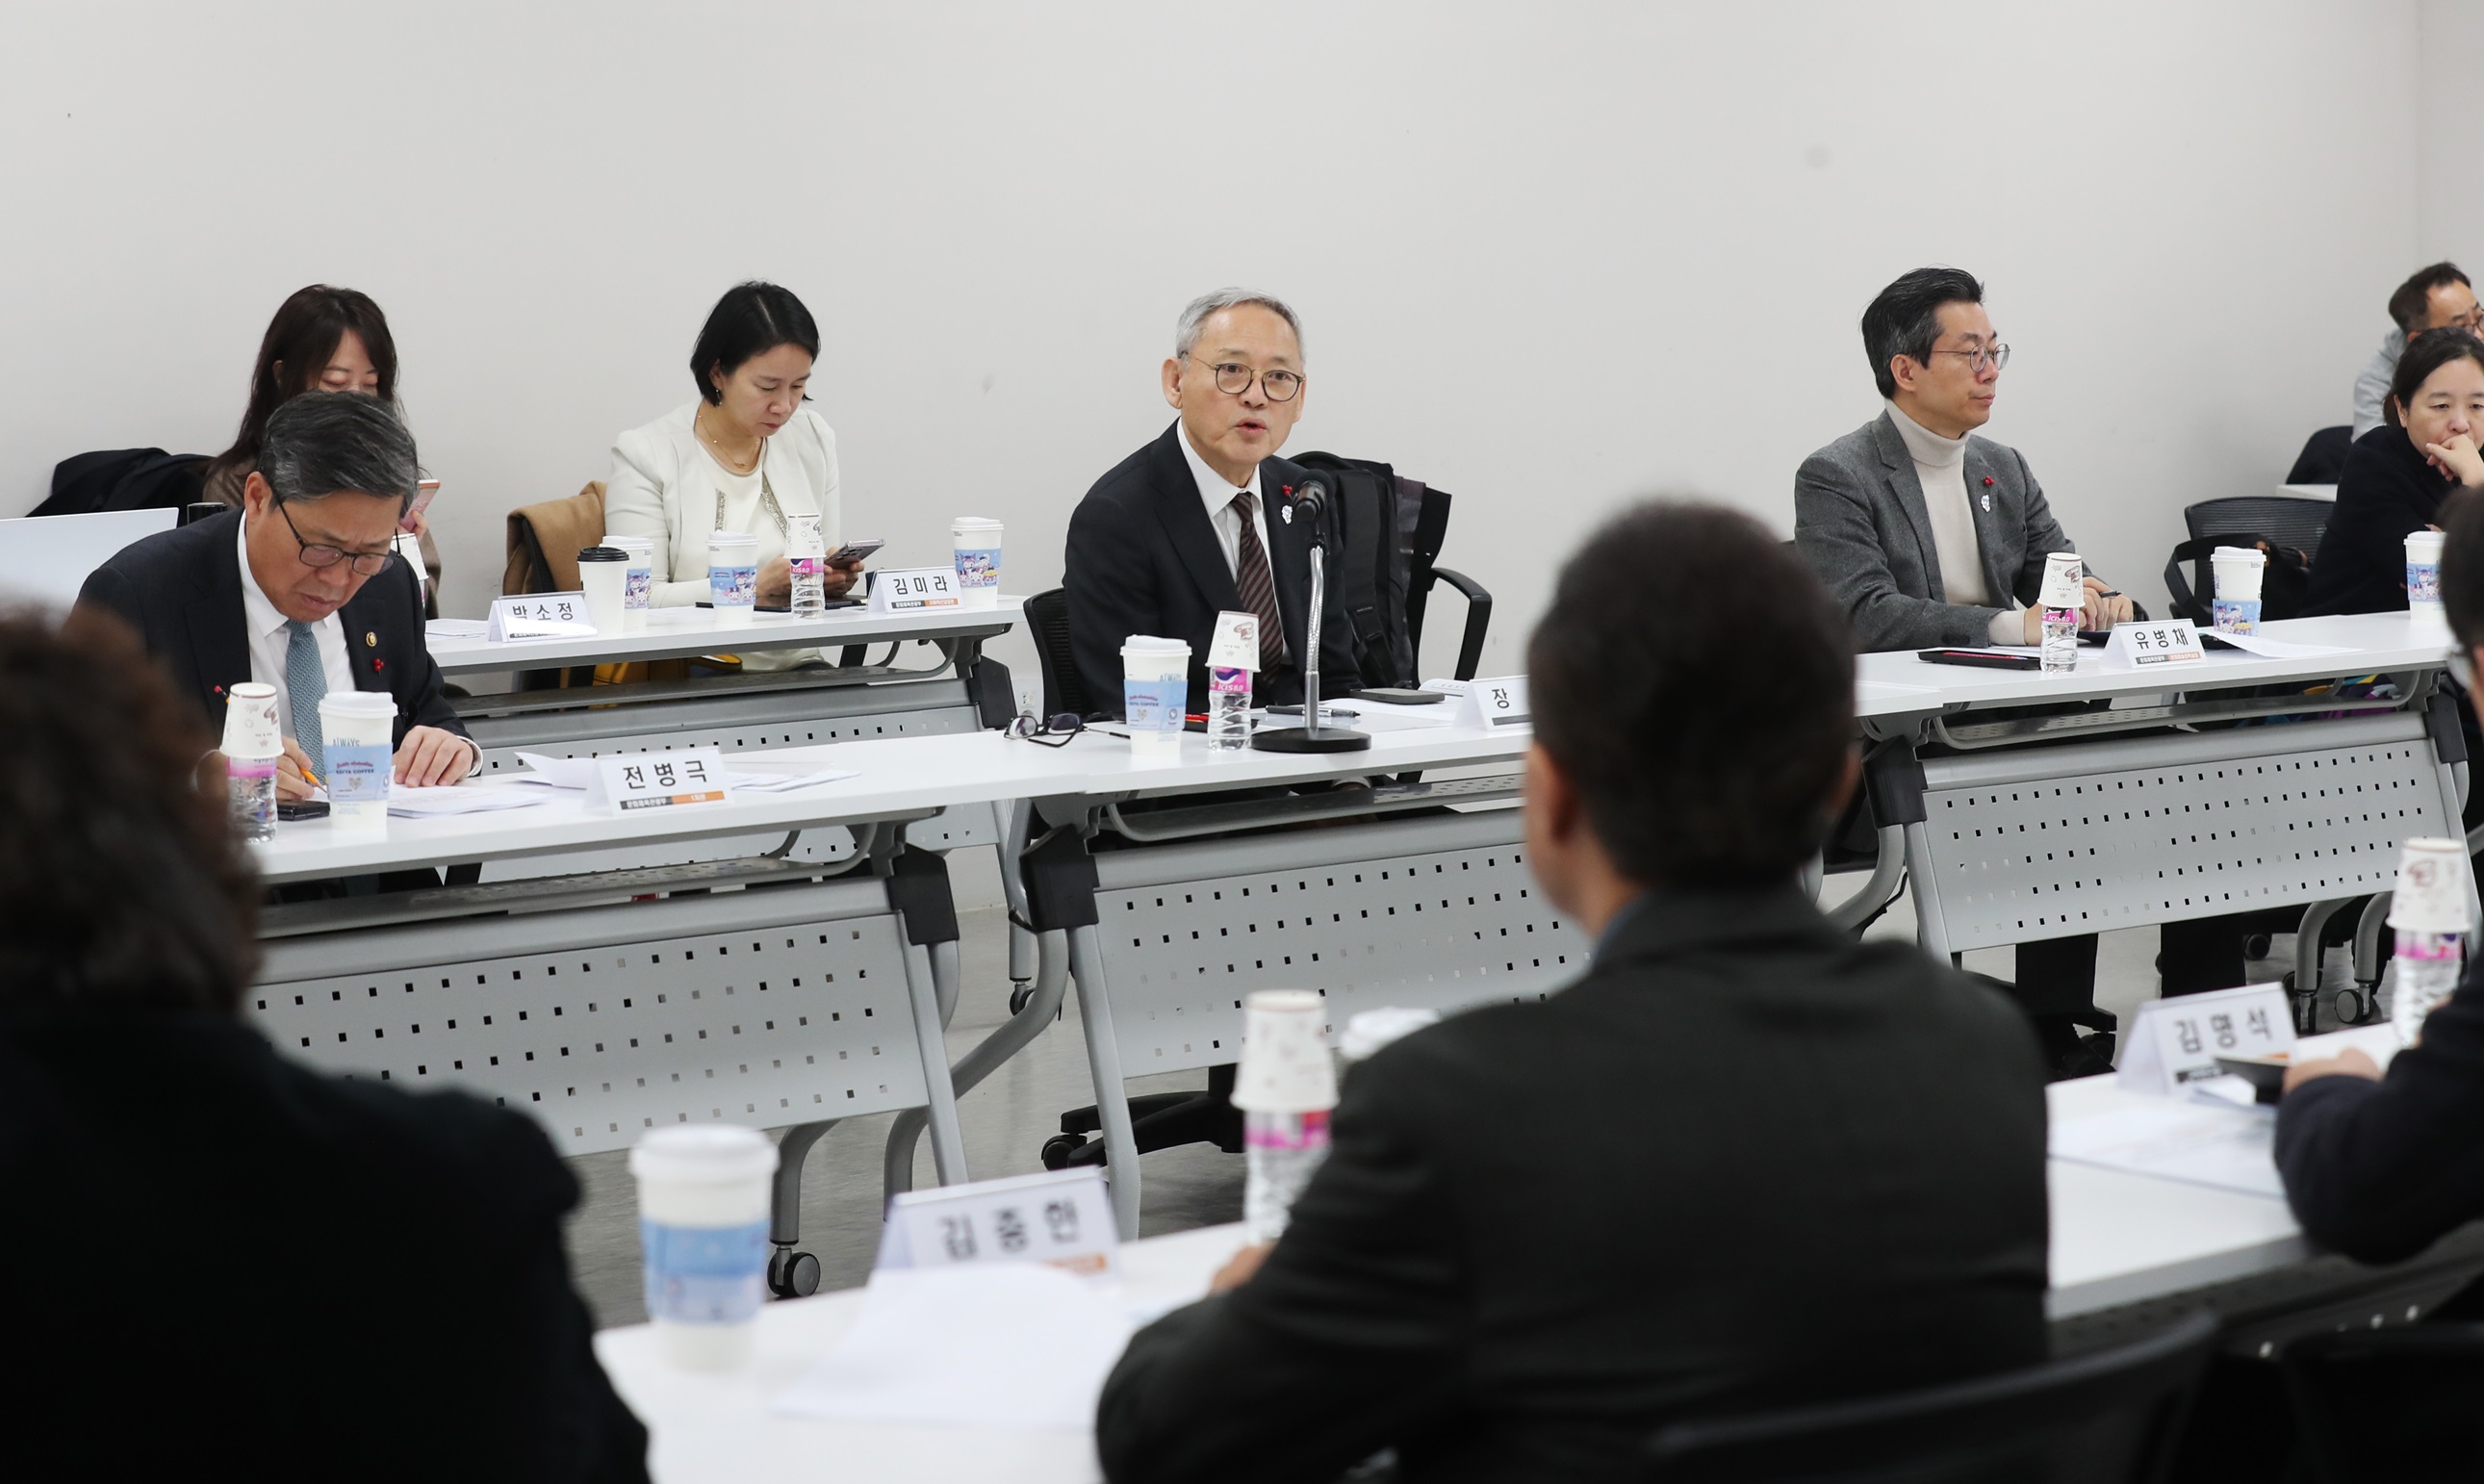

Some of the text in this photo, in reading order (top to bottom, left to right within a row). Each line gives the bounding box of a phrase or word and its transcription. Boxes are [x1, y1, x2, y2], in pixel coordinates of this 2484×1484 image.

[893, 576, 948, 595] 김미라
[512, 601, 574, 621] 박소정
[2135, 627, 2190, 650] 유병채
[1491, 687, 1510, 708] 장
[623, 759, 707, 790] 전병극
[2173, 1008, 2272, 1053] 김명석
